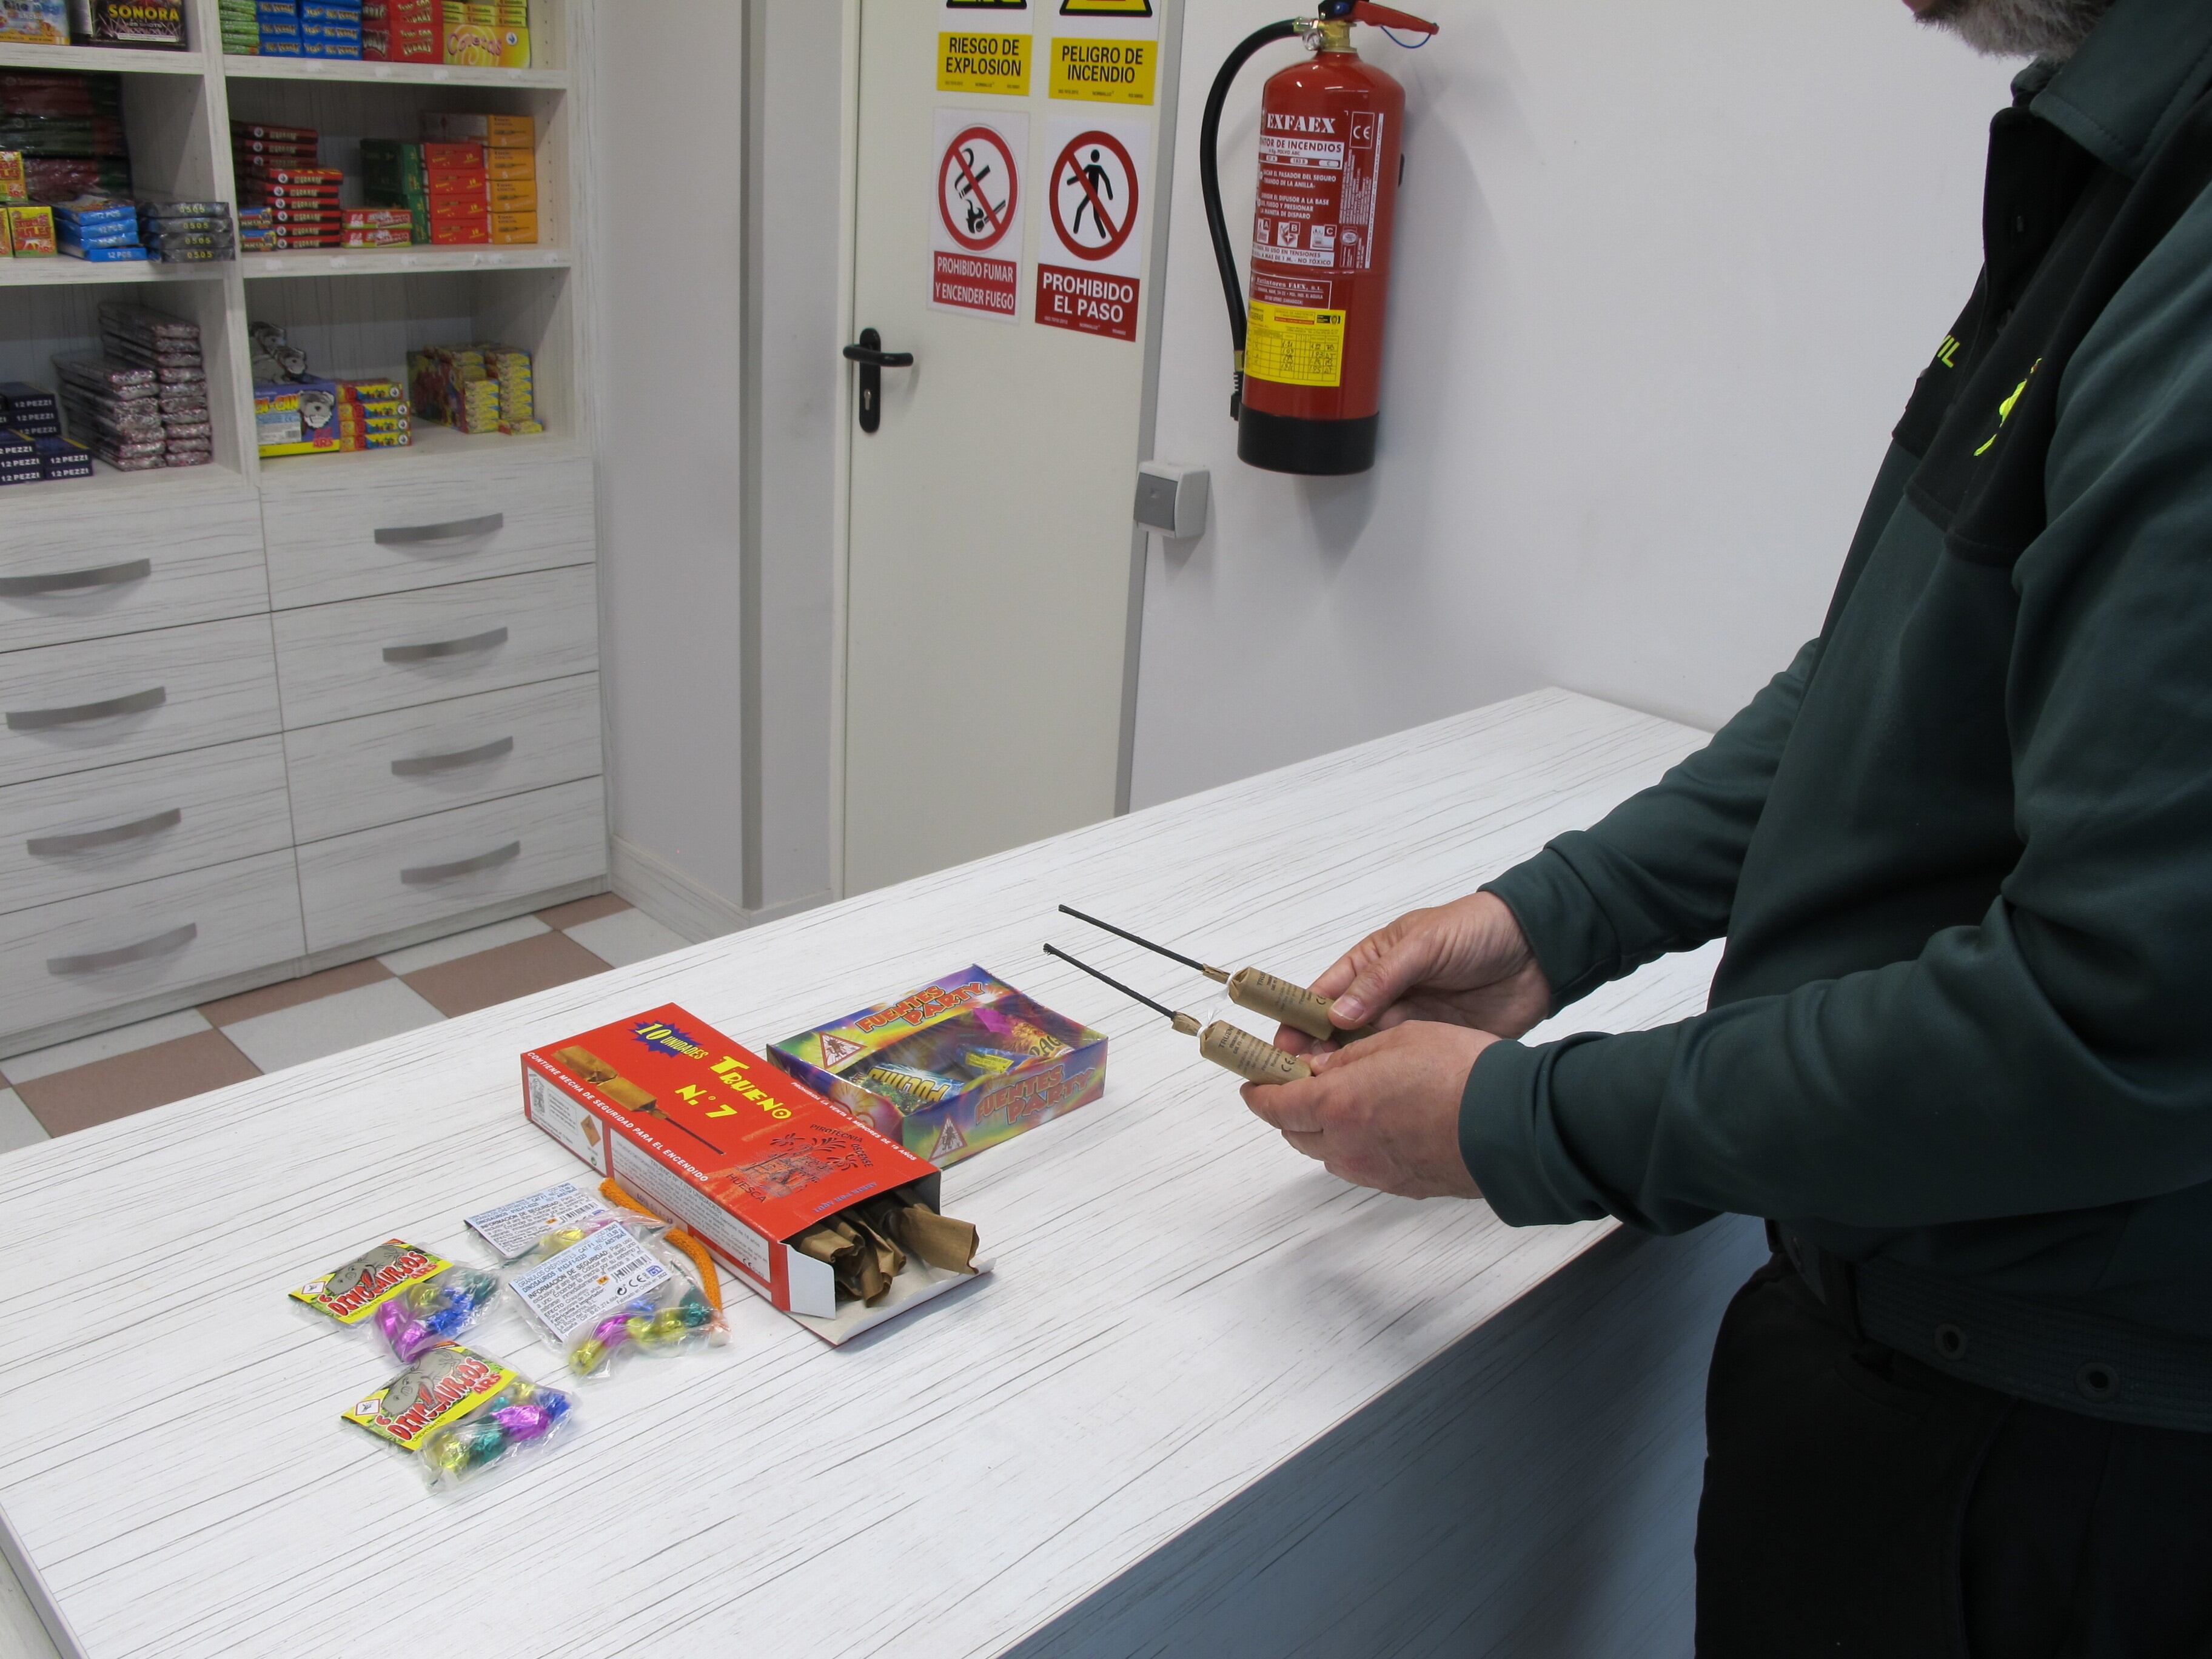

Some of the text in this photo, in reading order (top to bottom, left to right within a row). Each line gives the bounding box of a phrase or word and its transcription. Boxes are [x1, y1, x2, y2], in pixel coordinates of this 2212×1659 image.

[108, 4, 179, 21] SONORA
[949, 37, 1019, 56] RIESGO DE
[1062, 45, 1143, 65] PELIGRO DE
[946, 57, 1021, 77] EXPLOSION
[1067, 66, 1135, 84] INCENDIO
[1267, 113, 1336, 133] EXFAEX
[1276, 139, 1342, 153] DE INCENDIOS
[1284, 203, 1313, 212] PRESIONAR
[1290, 249, 1321, 258] TENSIONES
[937, 256, 1013, 283] PROHIBIDO FUMAR
[936, 284, 1014, 310] Y ENCENDER FUEGO
[1042, 272, 1133, 304] PROHIBIDO
[1054, 295, 1124, 323] EL PASO
[13, 458, 40, 466] PEZZI
[855, 985, 947, 1033] FUENTES
[902, 982, 986, 1026] PARTY
[636, 1023, 709, 1060] 10 UNIDADES
[710, 1056, 792, 1119] TRUENO
[974, 1065, 1066, 1125] FUENTES
[1008, 1068, 1096, 1125] PARTY
[527, 1051, 709, 1182] CONTIENE MECHA DE SEGURIDAD PARA EL ENCENDIDO
[705, 1104, 738, 1118] 7
[791, 1082, 820, 1101] PROHIBIDA
[829, 1105, 846, 1118] VENTA
[853, 1120, 881, 1139] MENORES
[898, 1149, 917, 1161] AÑOS
[809, 1124, 863, 1143] PIROTECNIA
[851, 1143, 874, 1168] OSCENSE
[726, 1173, 767, 1204] HUESCA
[411, 1262, 438, 1279] ARS
[526, 1273, 568, 1299] INFORMACIÓN
[318, 1294, 333, 1304] 6
[472, 1373, 502, 1394] ARS
[375, 1415, 392, 1427] 6
